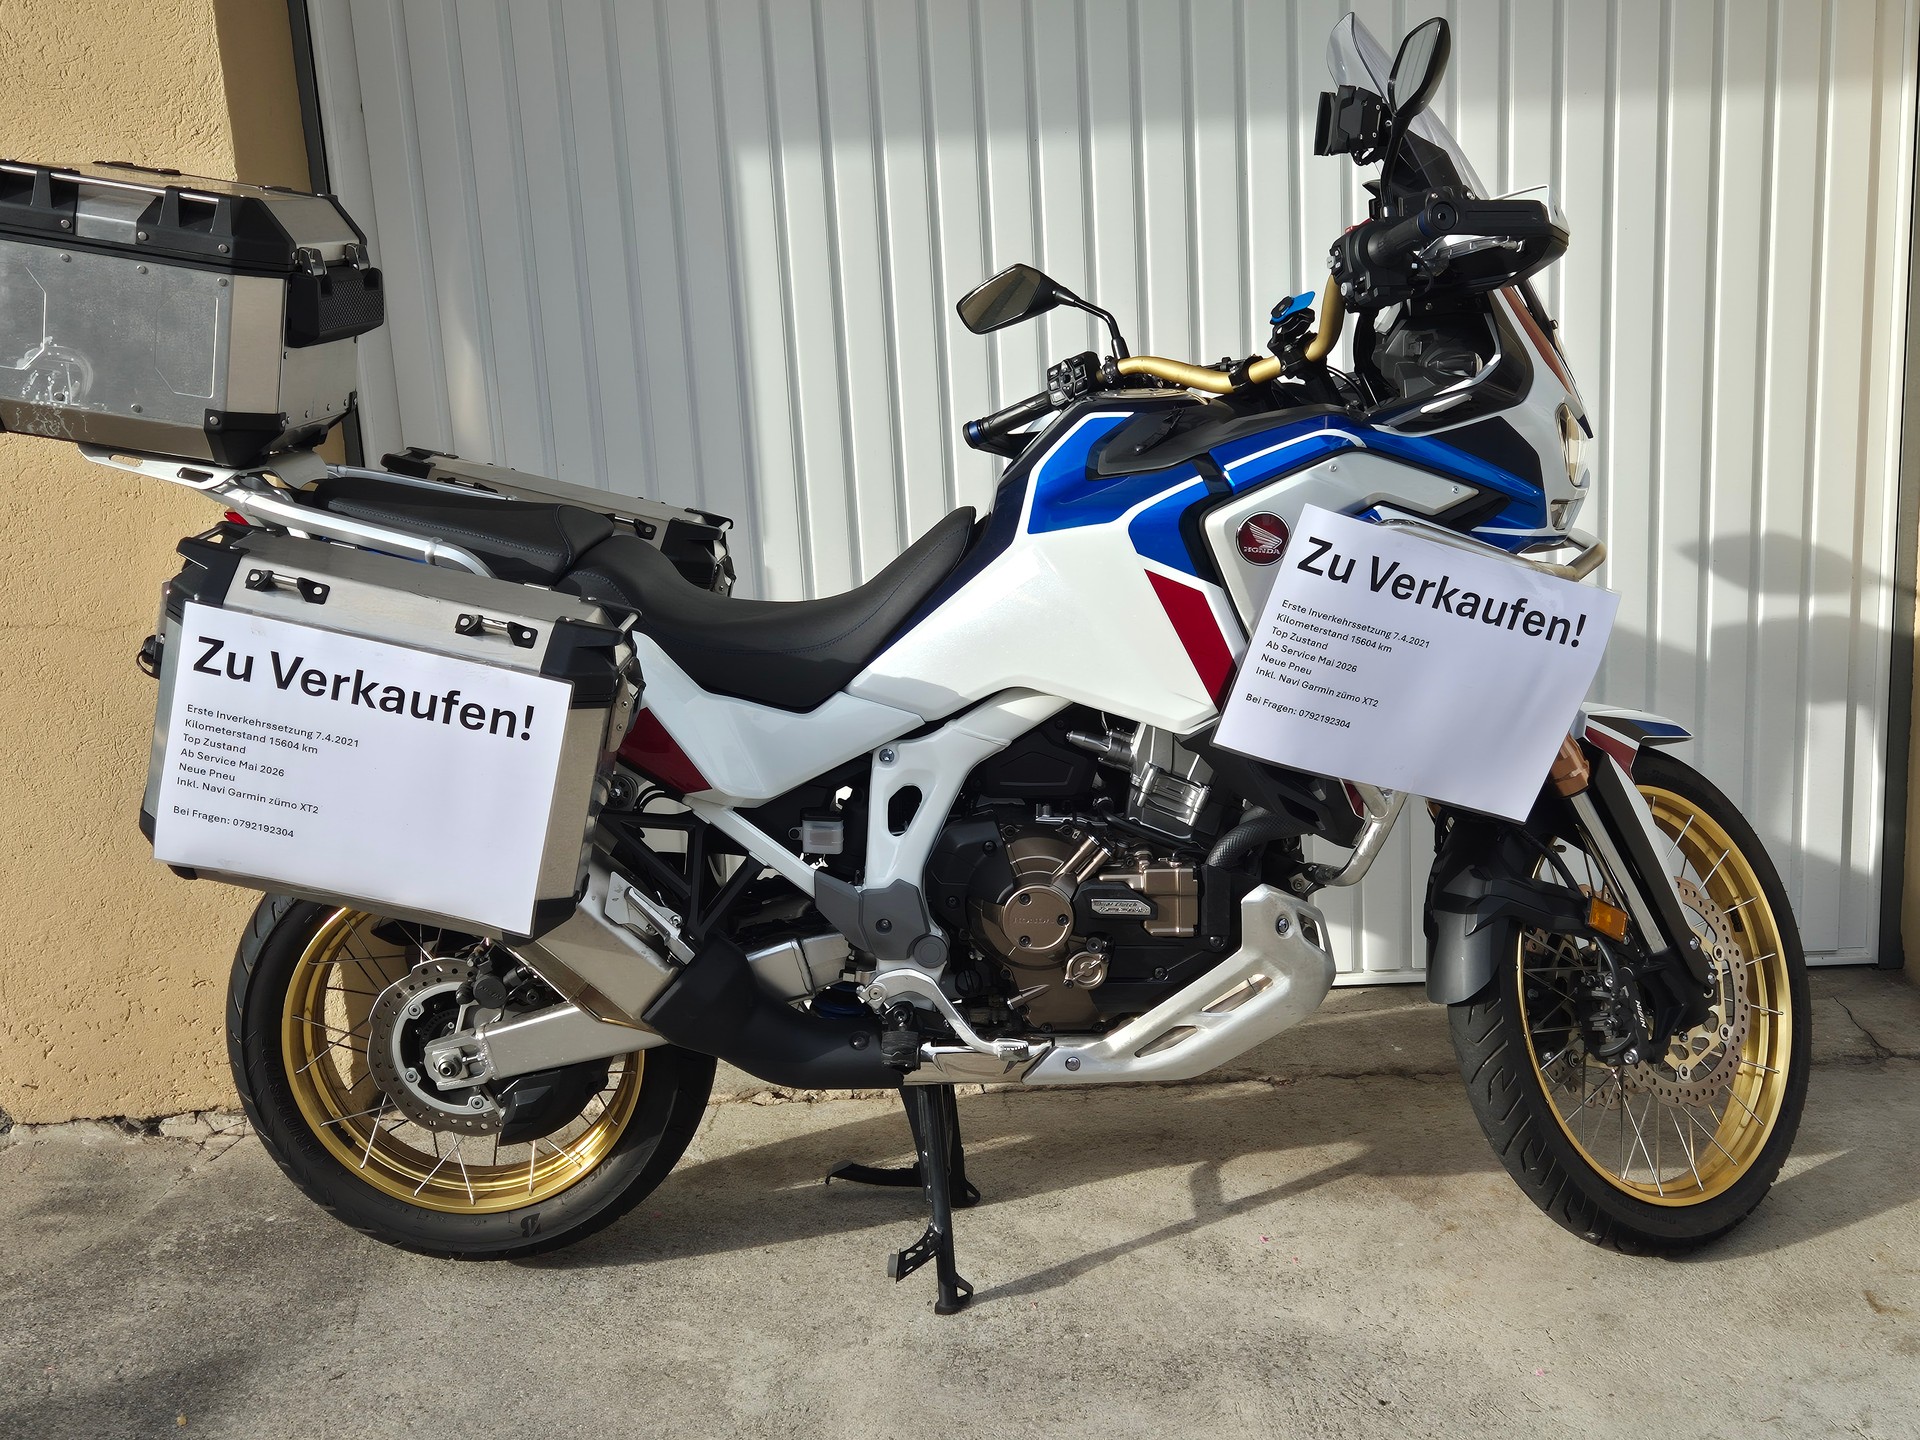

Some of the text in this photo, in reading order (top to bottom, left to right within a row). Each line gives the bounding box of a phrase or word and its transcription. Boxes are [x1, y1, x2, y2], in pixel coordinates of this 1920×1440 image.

[1243, 546, 1281, 555] HONDA
[1296, 536, 1587, 648] Zu Verkaufen!
[1272, 625, 1329, 651] Top Zustand
[1276, 612, 1393, 653] Kilometerstand 15604 km
[1281, 599, 1430, 649] Erste Inverkehrssetzung 7.4.2021
[1260, 652, 1313, 676] Neue Pneu
[1265, 640, 1358, 673] Ab Service Mai 2026
[192, 635, 535, 741] Zu Verkaufen!
[1255, 666, 1379, 708] Inkl. Navi Garmin zümo XT2
[187, 703, 359, 748] Erste Inverkehrssetzung 7.4.2021
[1245, 692, 1351, 729] Bei Fragen: 0792192304
[183, 732, 247, 755] Top Zustand
[184, 718, 318, 755] Kilometerstand 15604 km
[178, 762, 236, 782] Neue Pneu
[180, 747, 285, 778] Ab Service Mai 2026
[176, 776, 319, 815] Inkl. Navi Garmin zümo XT2
[173, 805, 294, 838] Bei Fragen: 0792192304
